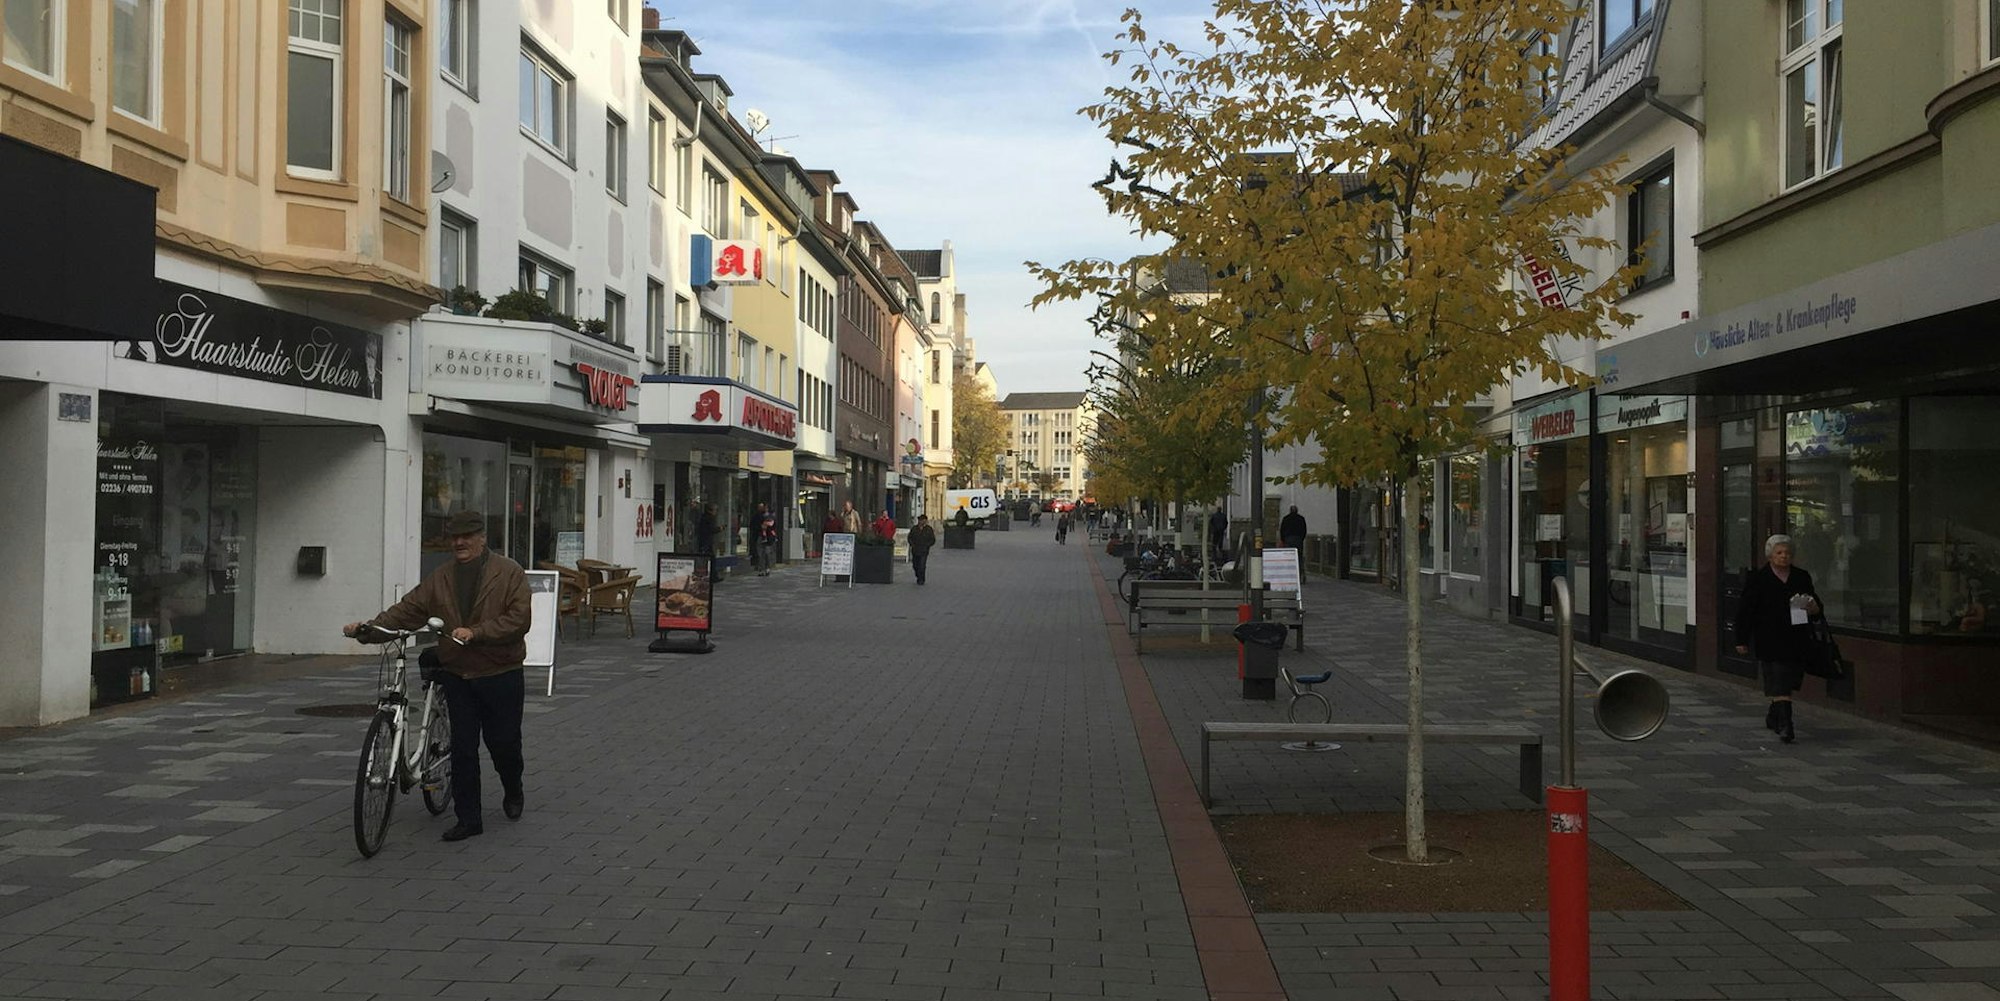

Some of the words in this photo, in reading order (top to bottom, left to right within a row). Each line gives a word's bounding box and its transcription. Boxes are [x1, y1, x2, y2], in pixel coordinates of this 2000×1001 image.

[1748, 318, 1774, 341] Alten-
[1776, 312, 1783, 334] &
[1786, 293, 1857, 331] Krankenpflege
[156, 293, 293, 376] Haarstudio
[295, 326, 361, 388] Helen
[435, 363, 541, 379] KONDITOREI
[742, 396, 796, 440] APOTHEKE
[1618, 398, 1661, 427] Augenoptik
[1532, 409, 1576, 440] WEIBELER
[101, 483, 121, 493] 02236
[970, 496, 989, 509] GLS
[108, 553, 128, 567] 9-18
[107, 586, 128, 601] 9-17
